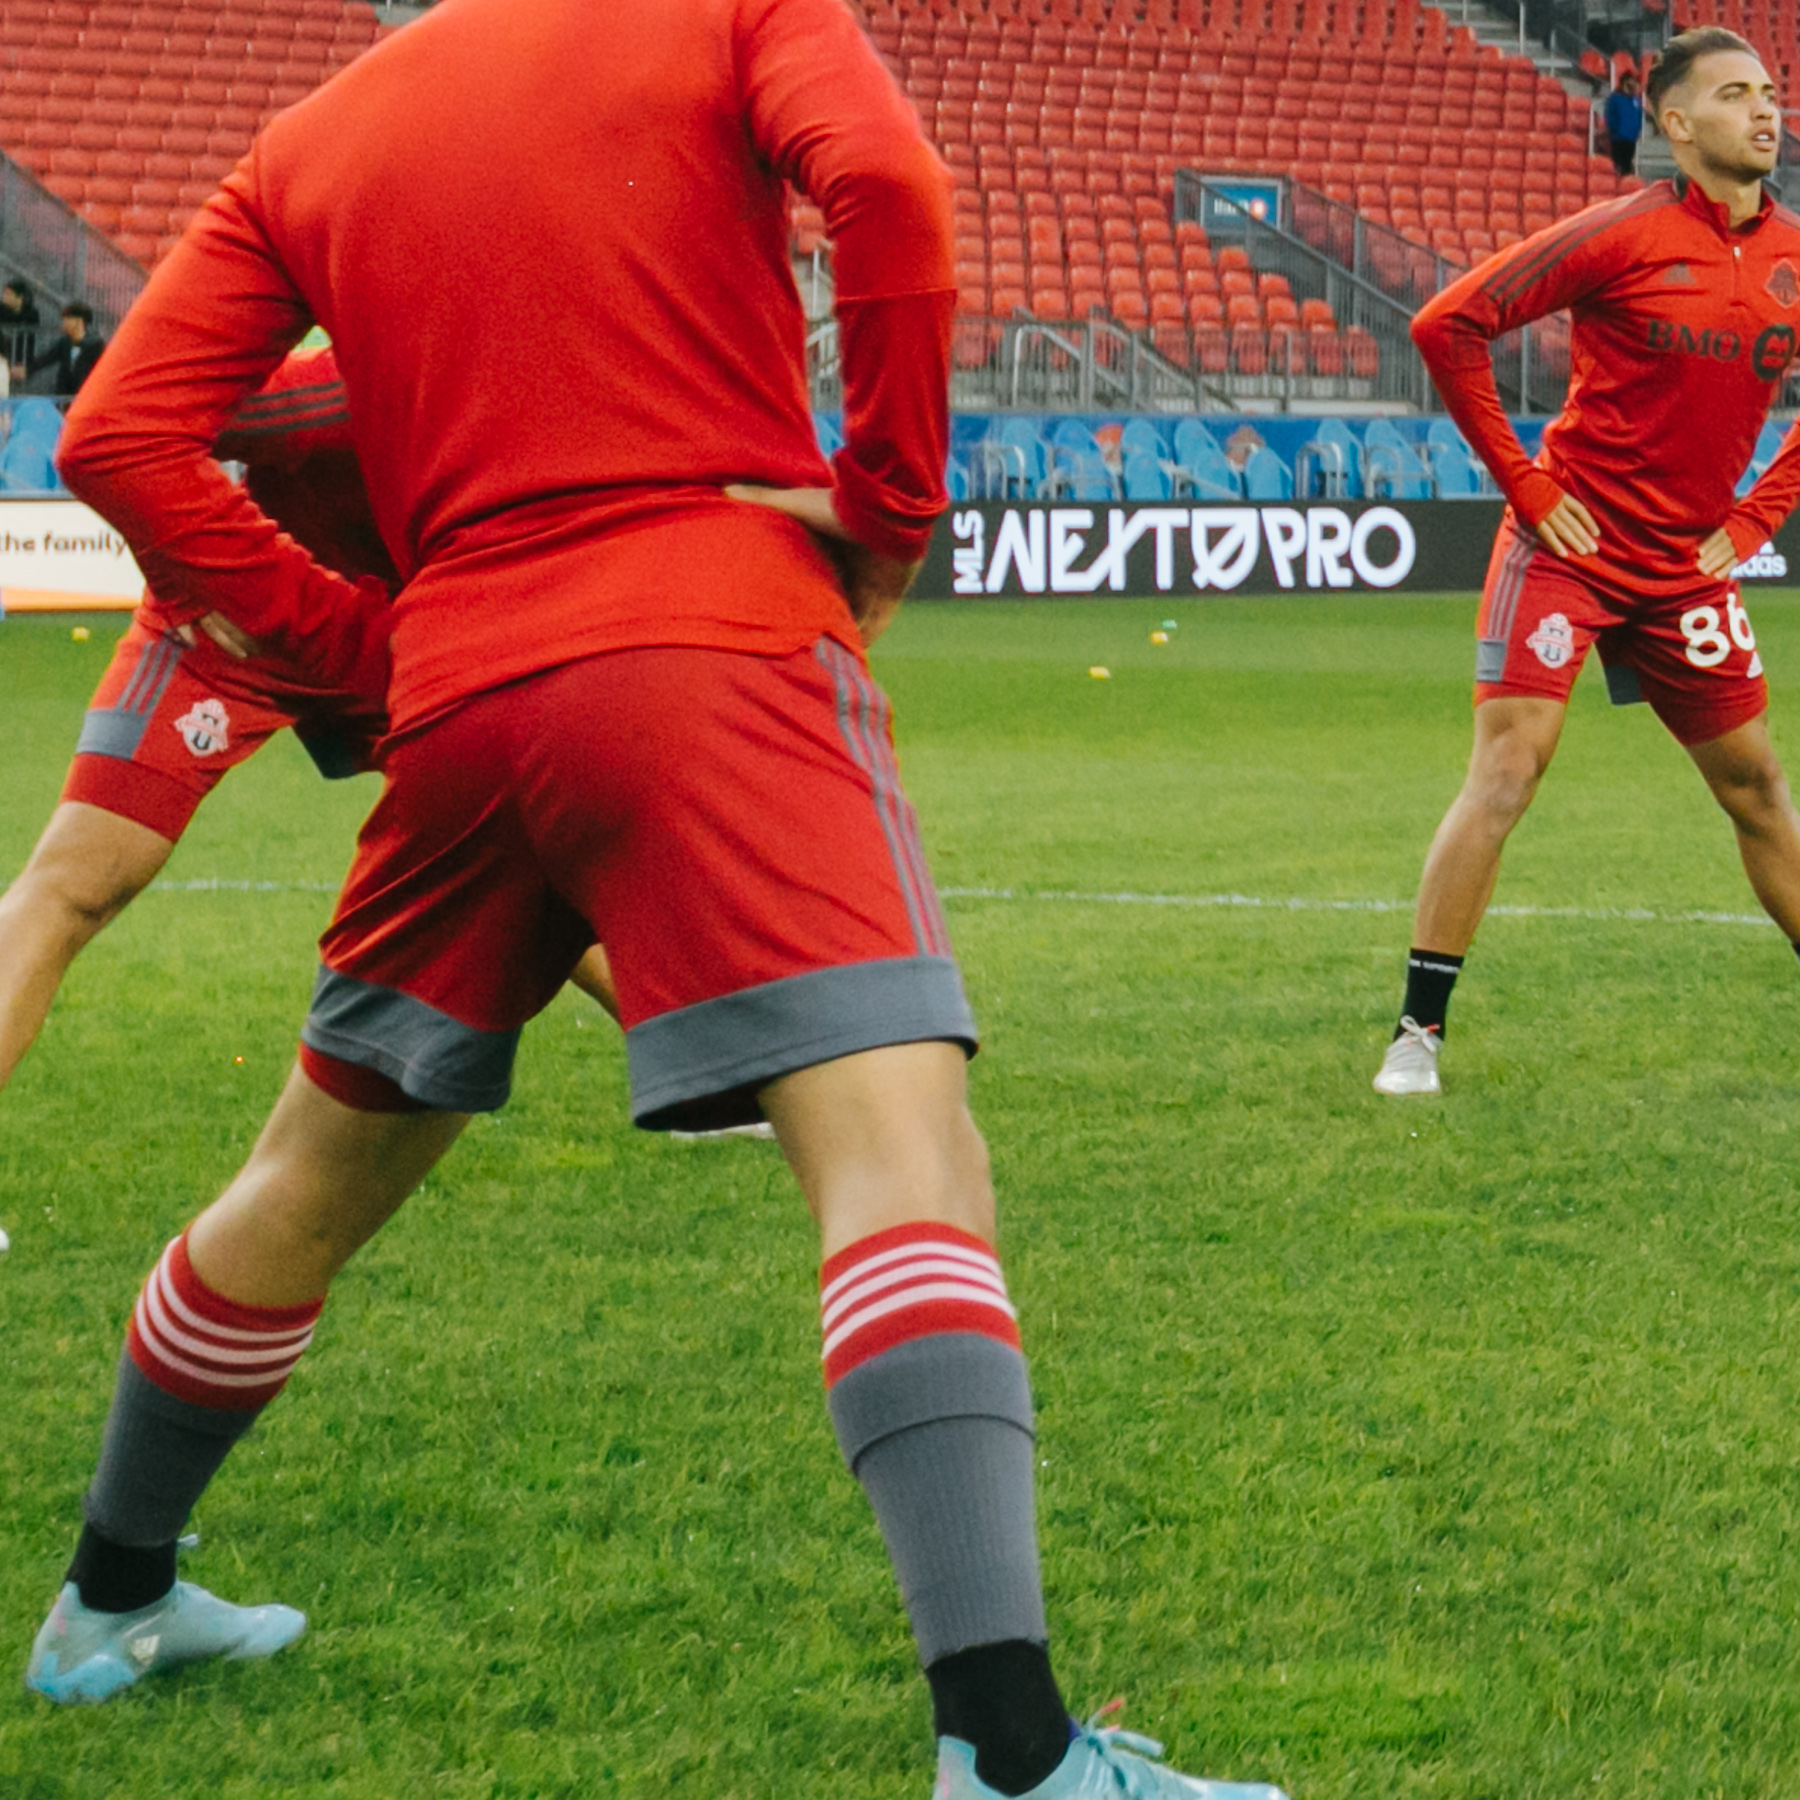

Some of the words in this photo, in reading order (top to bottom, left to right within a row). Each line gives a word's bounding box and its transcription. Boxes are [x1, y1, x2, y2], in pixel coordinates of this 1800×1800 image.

[1647, 320, 1740, 363] BMO
[0, 532, 35, 552] he
[44, 531, 128, 558] family
[953, 509, 985, 594] MLS
[1679, 592, 1756, 668] 86
